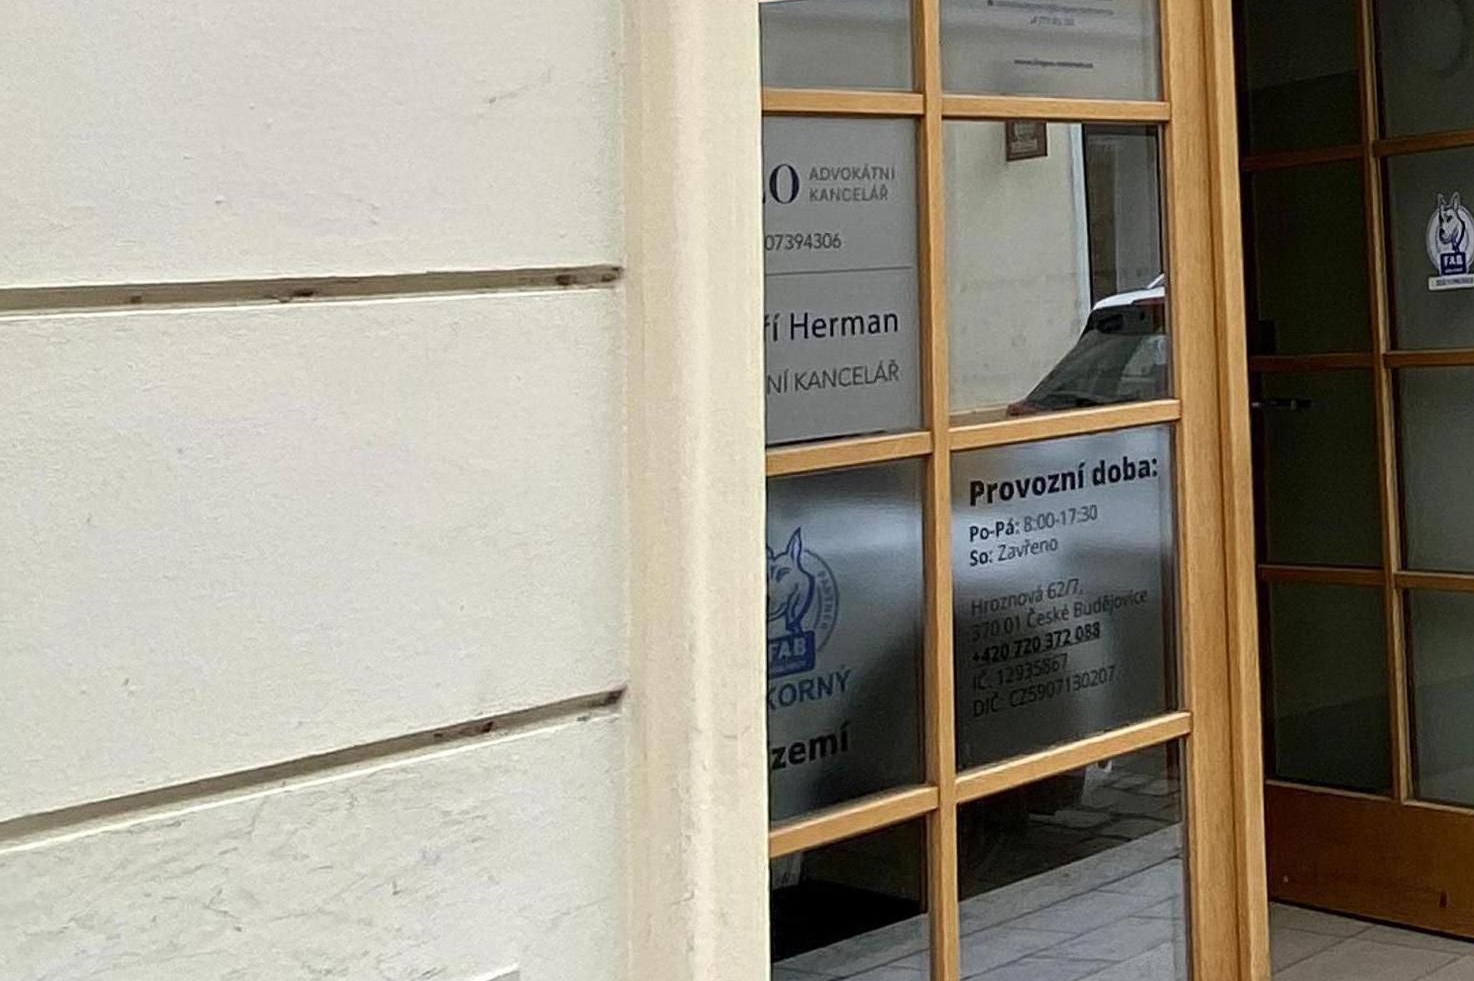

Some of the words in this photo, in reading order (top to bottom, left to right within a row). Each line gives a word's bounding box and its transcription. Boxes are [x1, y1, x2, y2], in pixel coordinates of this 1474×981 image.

[789, 311, 899, 341] Herman
[795, 358, 900, 392] KANCELÁŘ
[969, 461, 1086, 507] Provozní
[1092, 455, 1158, 487] doba:
[969, 519, 1021, 543] Po-Pá:
[969, 549, 994, 568] So:
[997, 536, 1059, 562] Zavřeno
[971, 585, 1043, 617] Hroznová
[1073, 589, 1149, 619] Budějovice
[1012, 635, 1042, 658] 720
[1044, 628, 1072, 650] 372
[770, 719, 852, 771] zemí
